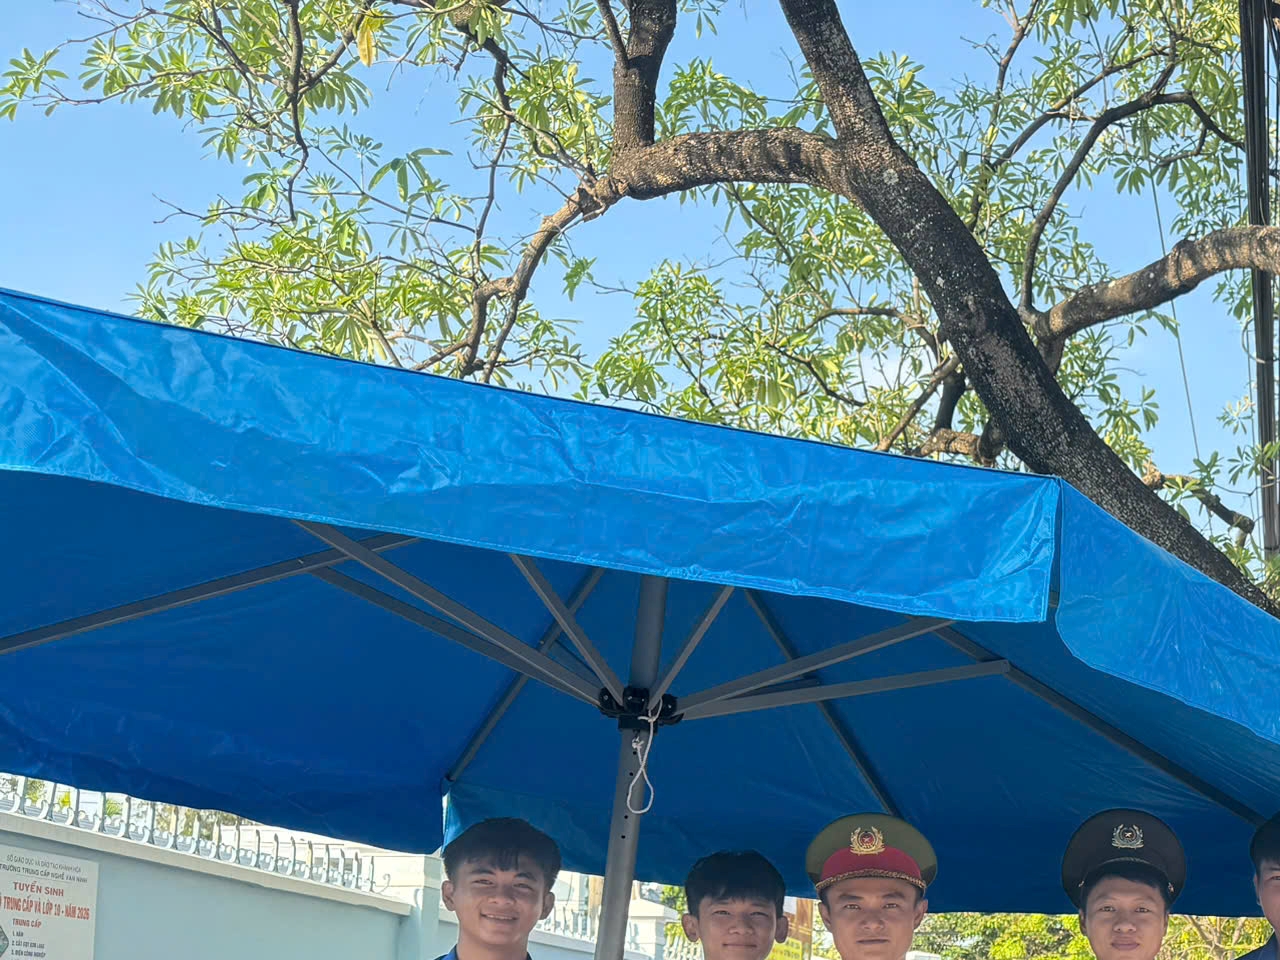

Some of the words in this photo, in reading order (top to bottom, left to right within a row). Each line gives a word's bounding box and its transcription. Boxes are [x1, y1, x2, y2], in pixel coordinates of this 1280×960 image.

[13, 881, 42, 894] TUYỂN
[44, 887, 64, 897] SINH
[4, 896, 21, 911] TRUNG
[22, 895, 33, 912] CẤP
